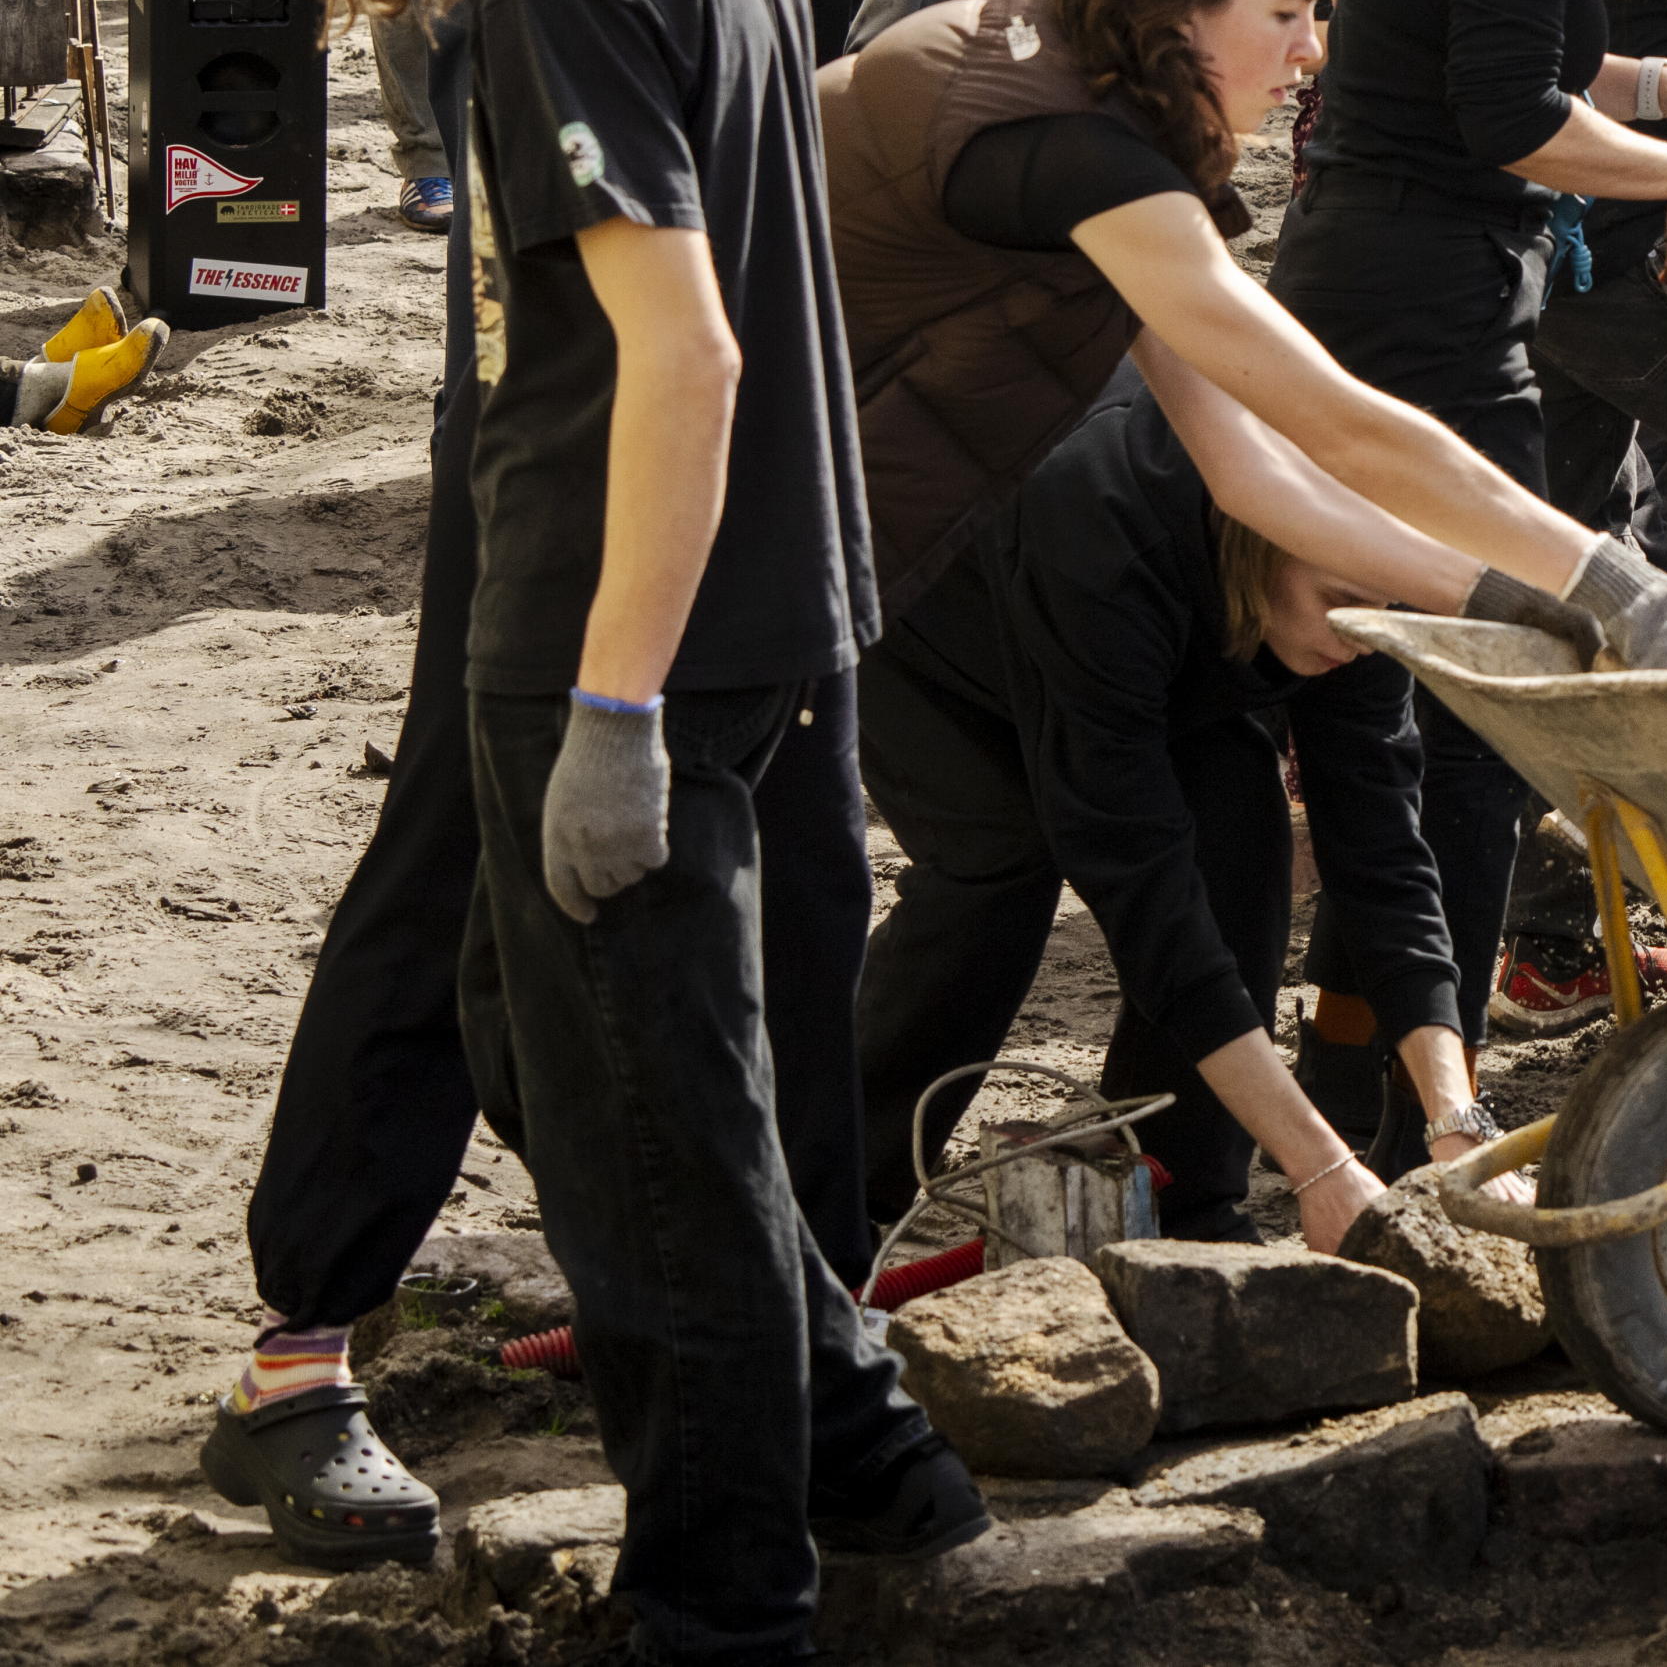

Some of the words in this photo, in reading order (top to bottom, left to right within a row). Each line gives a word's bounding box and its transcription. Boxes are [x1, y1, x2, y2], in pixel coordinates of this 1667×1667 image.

[174, 157, 198, 170] HAV
[195, 268, 226, 286] THE
[232, 272, 302, 293] ESSENCE
